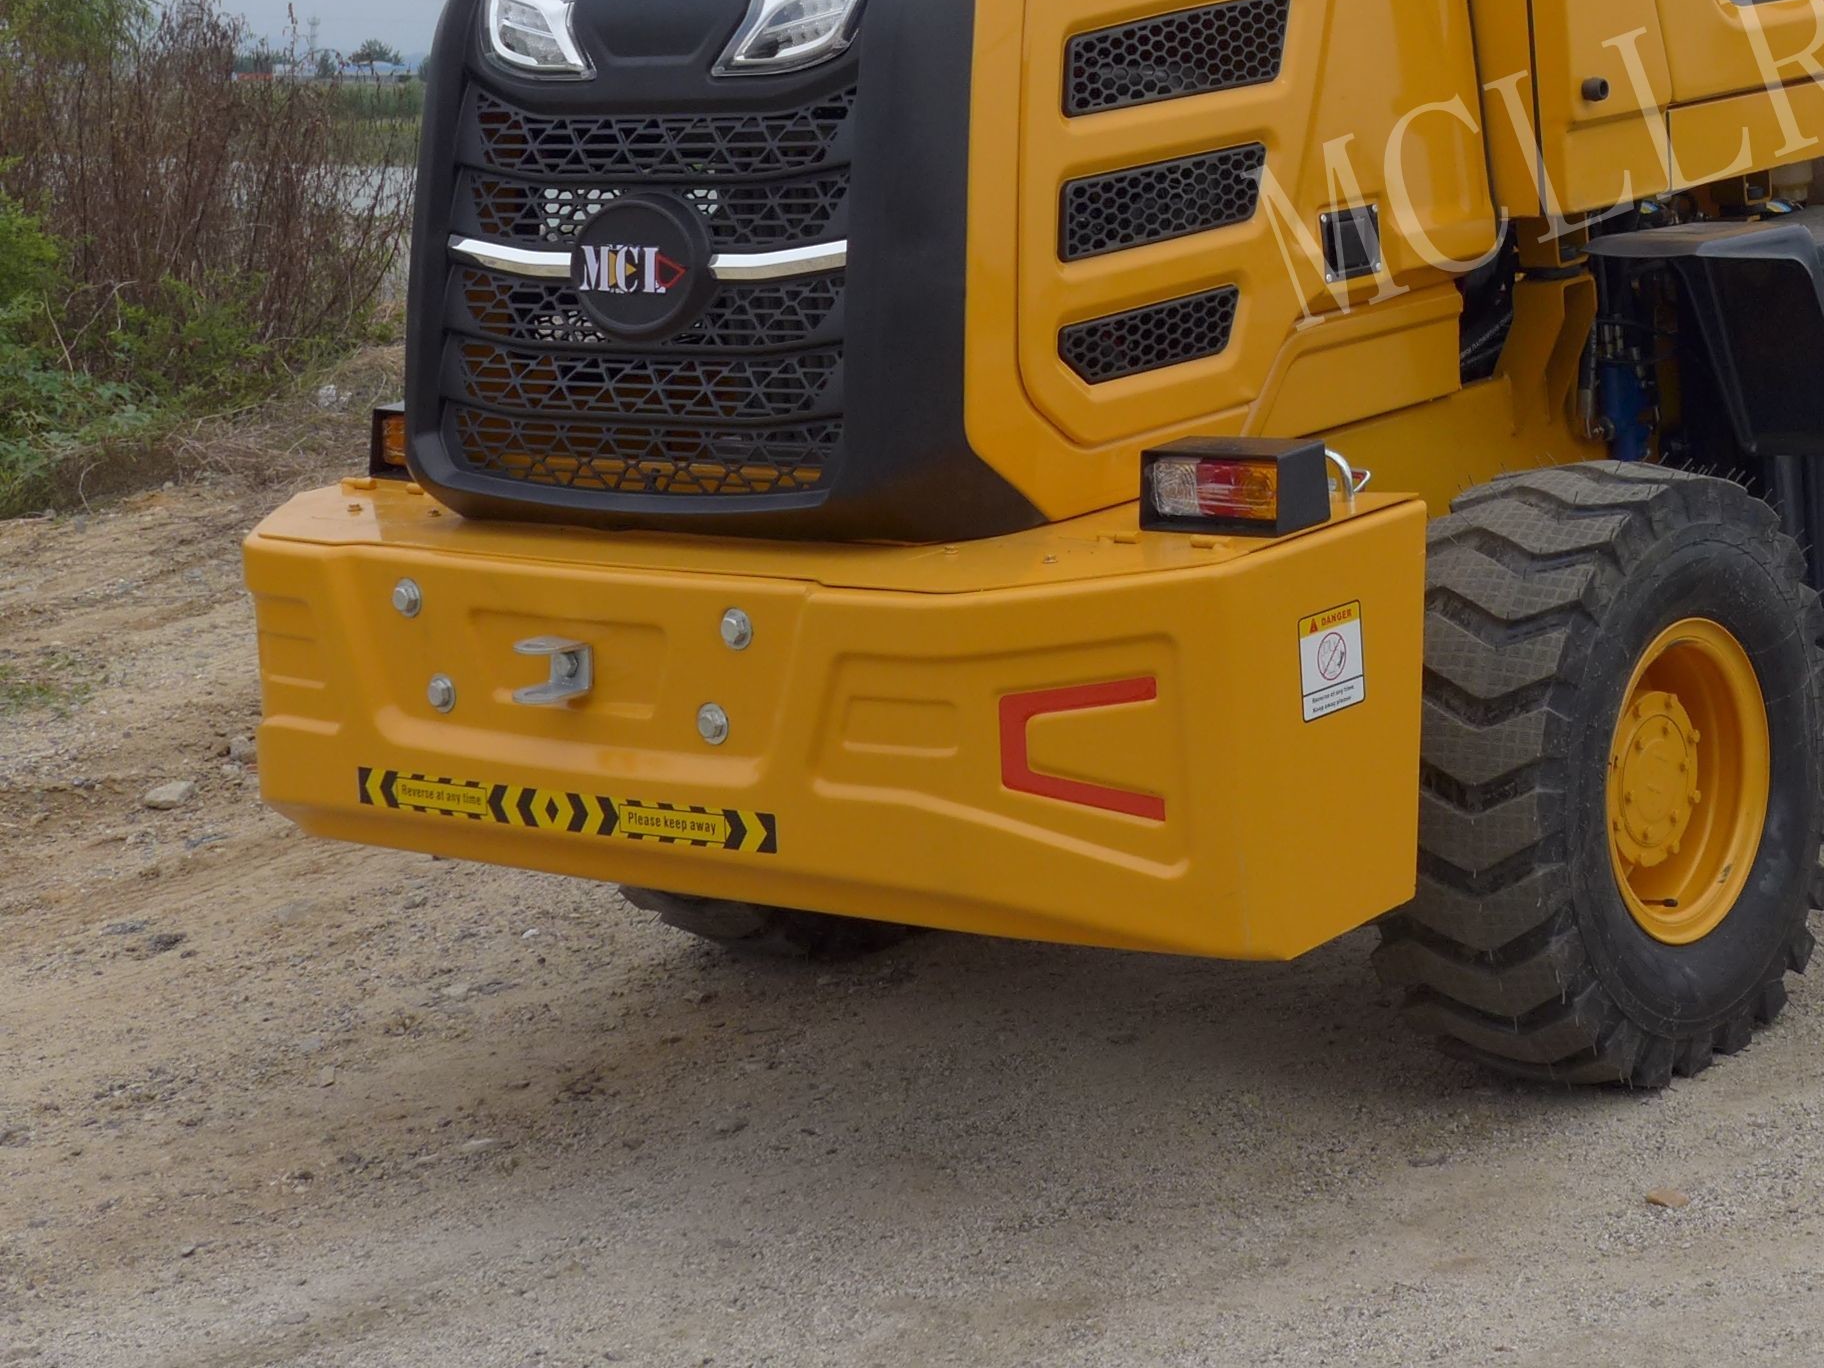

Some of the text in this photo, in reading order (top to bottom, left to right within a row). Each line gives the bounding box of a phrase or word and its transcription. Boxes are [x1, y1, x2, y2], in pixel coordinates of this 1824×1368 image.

[578, 243, 667, 294] MCL
[1321, 608, 1352, 626] DANGER
[401, 784, 481, 806] Reverse at any time
[628, 812, 716, 835] Please keep away
